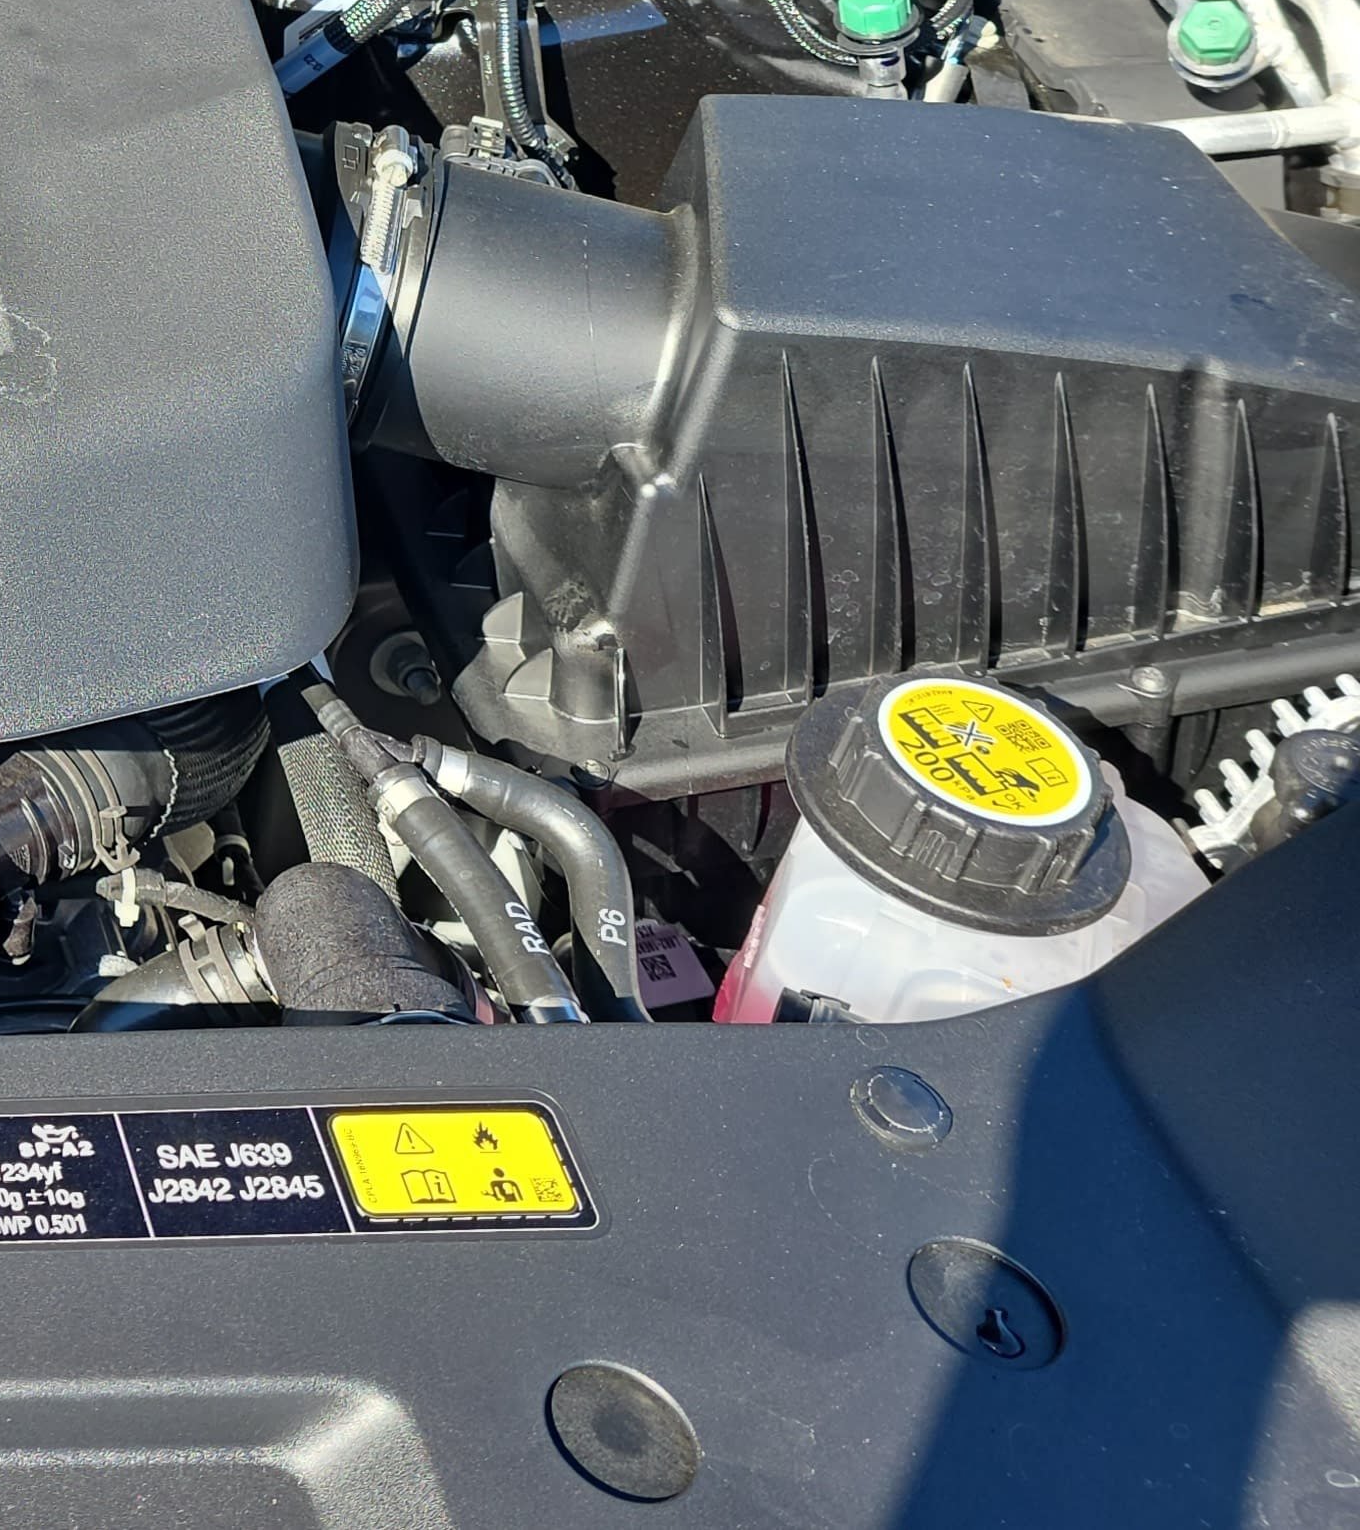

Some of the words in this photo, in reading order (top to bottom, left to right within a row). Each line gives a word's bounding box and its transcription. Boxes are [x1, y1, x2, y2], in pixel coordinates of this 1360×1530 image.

[898, 735, 955, 782] 200
[1003, 793, 1036, 811] OK
[505, 901, 552, 955] RAD
[598, 908, 627, 947] P6
[18, 1140, 96, 1158] SP-A2
[156, 1143, 221, 1170] SAE
[224, 1142, 293, 1168] J639
[25, 1188, 86, 1209] ±10g
[148, 1177, 236, 1204] J2842
[239, 1174, 326, 1201] J2845
[34, 1213, 88, 1236] 0.501
